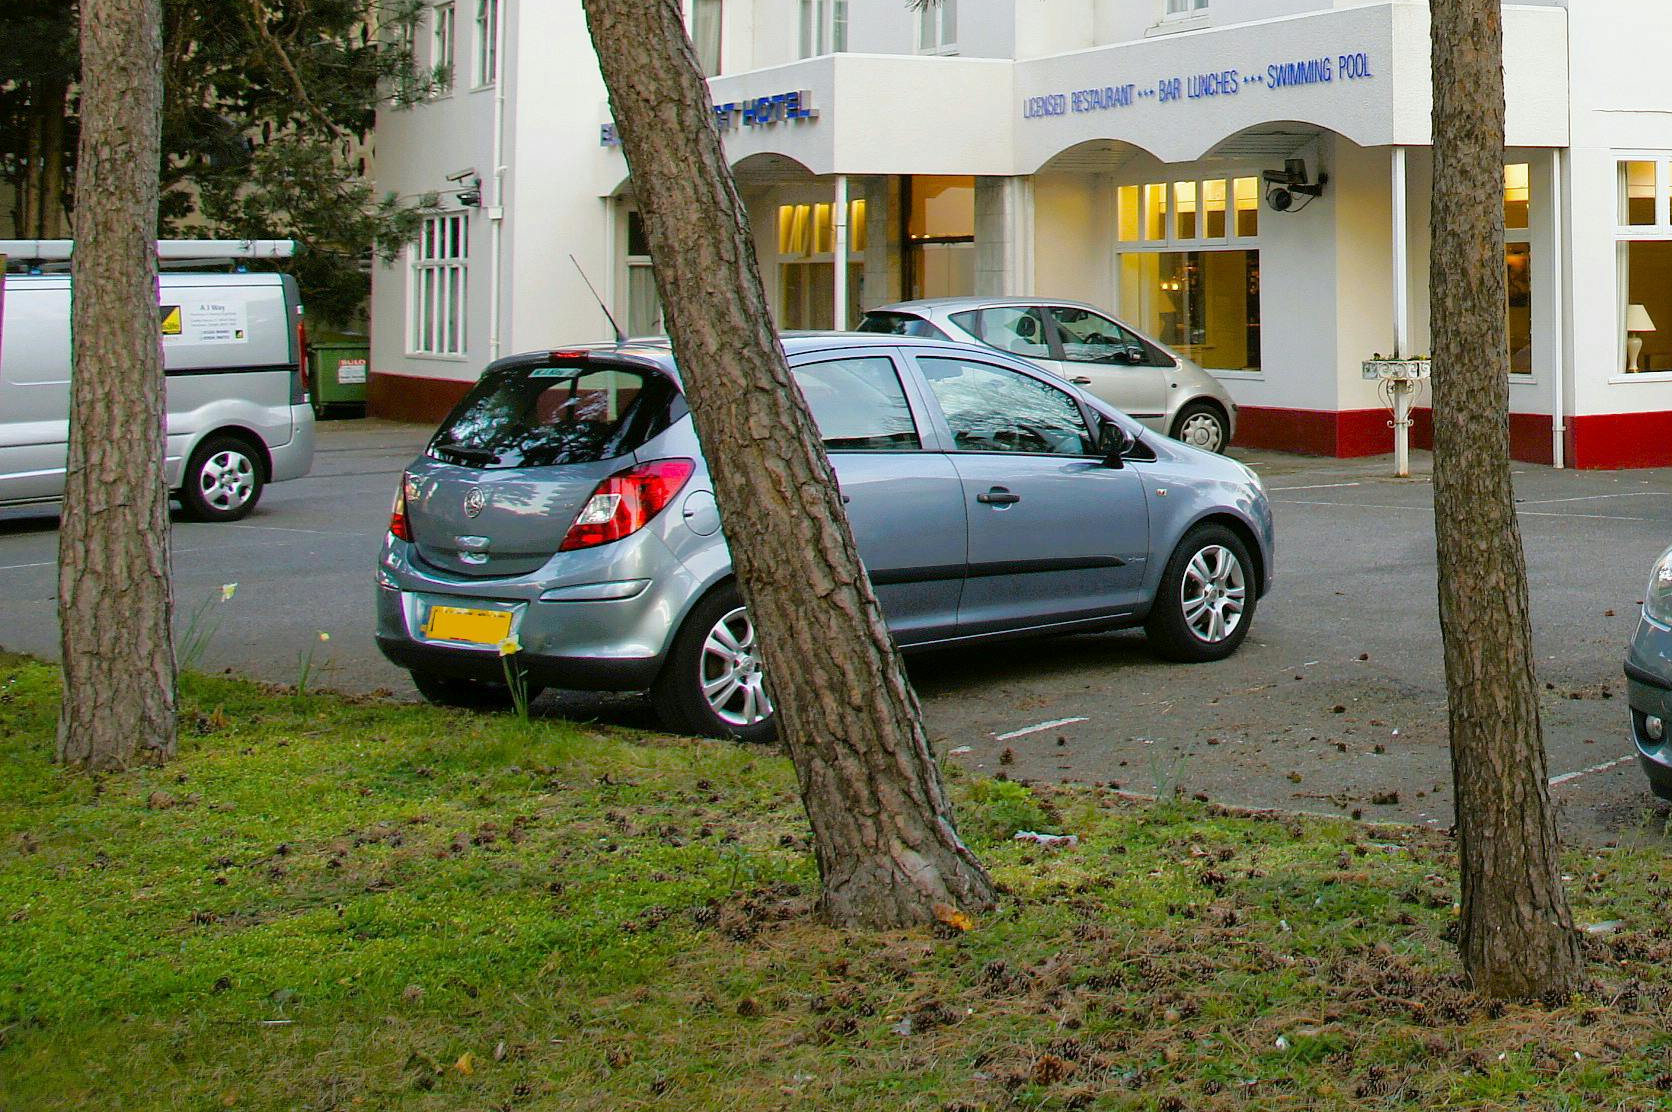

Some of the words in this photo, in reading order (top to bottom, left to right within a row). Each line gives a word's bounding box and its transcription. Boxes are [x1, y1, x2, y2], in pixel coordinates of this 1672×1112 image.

[743, 90, 820, 127] HOTEL
[1023, 94, 1065, 118] LICENSED
[1071, 84, 1135, 112] RESTAURANT
[1159, 78, 1181, 102] BAR
[1187, 70, 1239, 98] LUNCHES
[1267, 57, 1331, 88] SWIMMING
[1339, 53, 1372, 79] POOL
